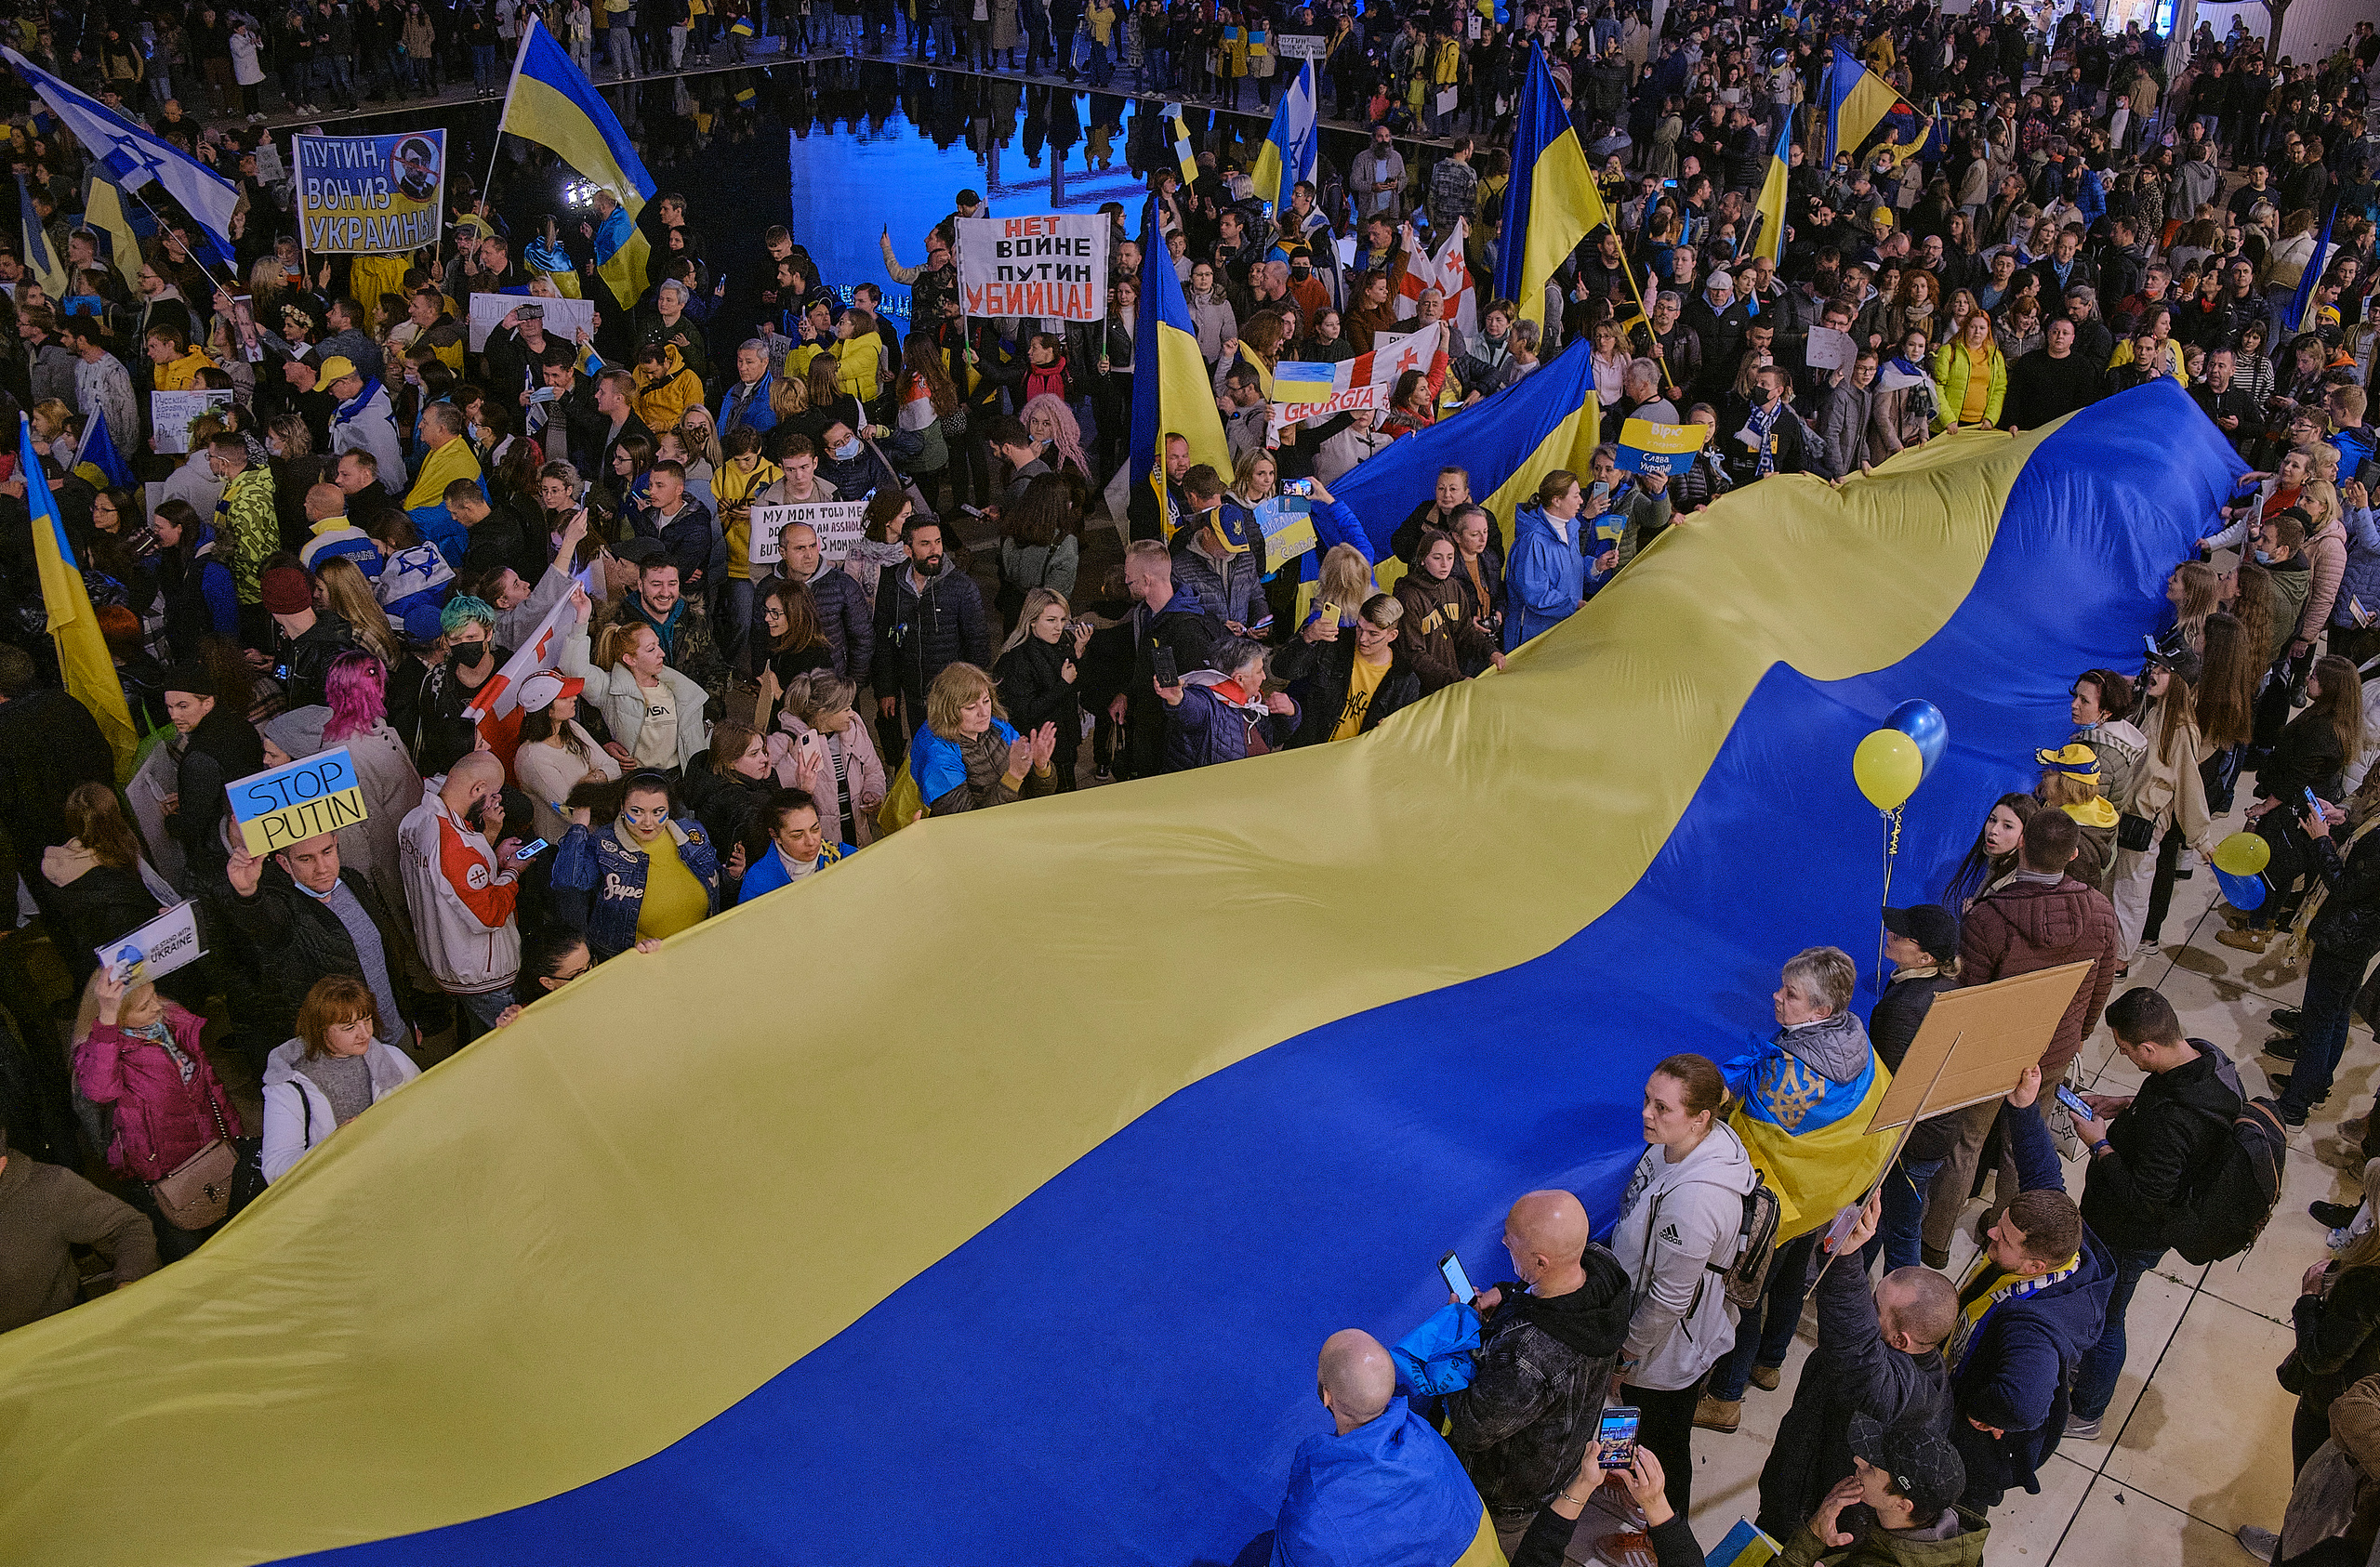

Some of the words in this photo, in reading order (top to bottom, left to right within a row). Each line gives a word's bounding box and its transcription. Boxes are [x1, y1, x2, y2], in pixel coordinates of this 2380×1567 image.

[302, 139, 386, 172] ПУТИН,
[307, 177, 355, 210] ВОН
[357, 177, 391, 210] ИЗ
[309, 203, 438, 249] УКРАИНЫ!
[1005, 216, 1061, 238] НЕТ
[996, 234, 1091, 258] ВОЙНЕ
[998, 263, 1091, 282] ПУТИН
[966, 281, 1092, 320] УБИЙЦА!
[1285, 388, 1374, 422] GEORGIA
[1642, 453, 1671, 464] Слава
[763, 509, 783, 524] MY
[787, 507, 815, 521] MOM
[820, 507, 844, 519] TOLD
[848, 506, 863, 518] ME
[831, 520, 864, 533] ASSHOL
[248, 761, 343, 816] STOP
[261, 790, 362, 849] PUTIN
[151, 933, 192, 964] UKRAINE
[160, 933, 178, 948] STAND
[177, 926, 192, 939] WITH
[1659, 1231, 1683, 1245] adidas
